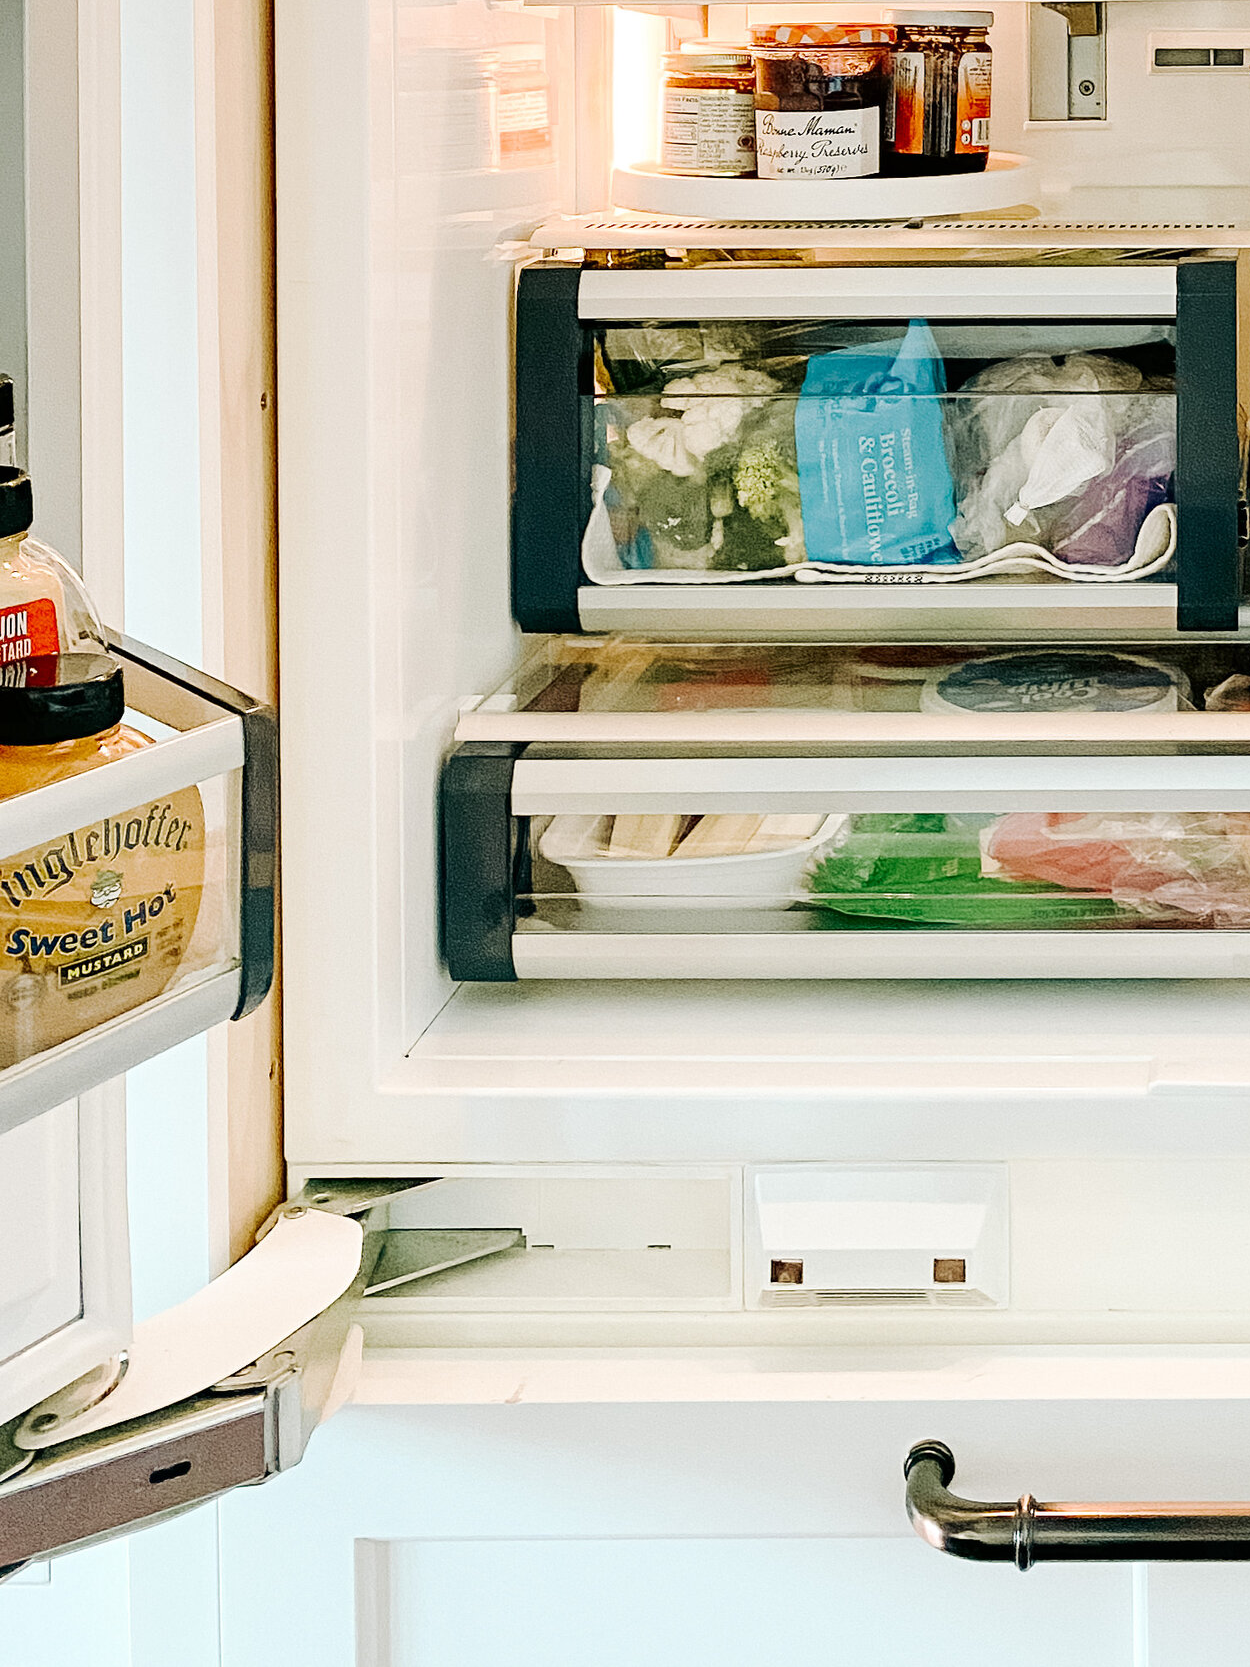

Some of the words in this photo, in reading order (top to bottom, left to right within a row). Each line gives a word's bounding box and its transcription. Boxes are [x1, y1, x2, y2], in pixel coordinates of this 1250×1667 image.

[757, 137, 808, 166] Raspberry
[810, 139, 869, 158] Preserves
[797, 115, 856, 136] Maman
[858, 436, 876, 454] &
[879, 433, 905, 517] Broccoli
[900, 428, 919, 519] Steam-in-Bag
[860, 457, 885, 564] Cauliflowe
[6, 919, 114, 956] Sweet
[123, 882, 177, 934] Hot
[67, 942, 144, 981] MUSTARD
